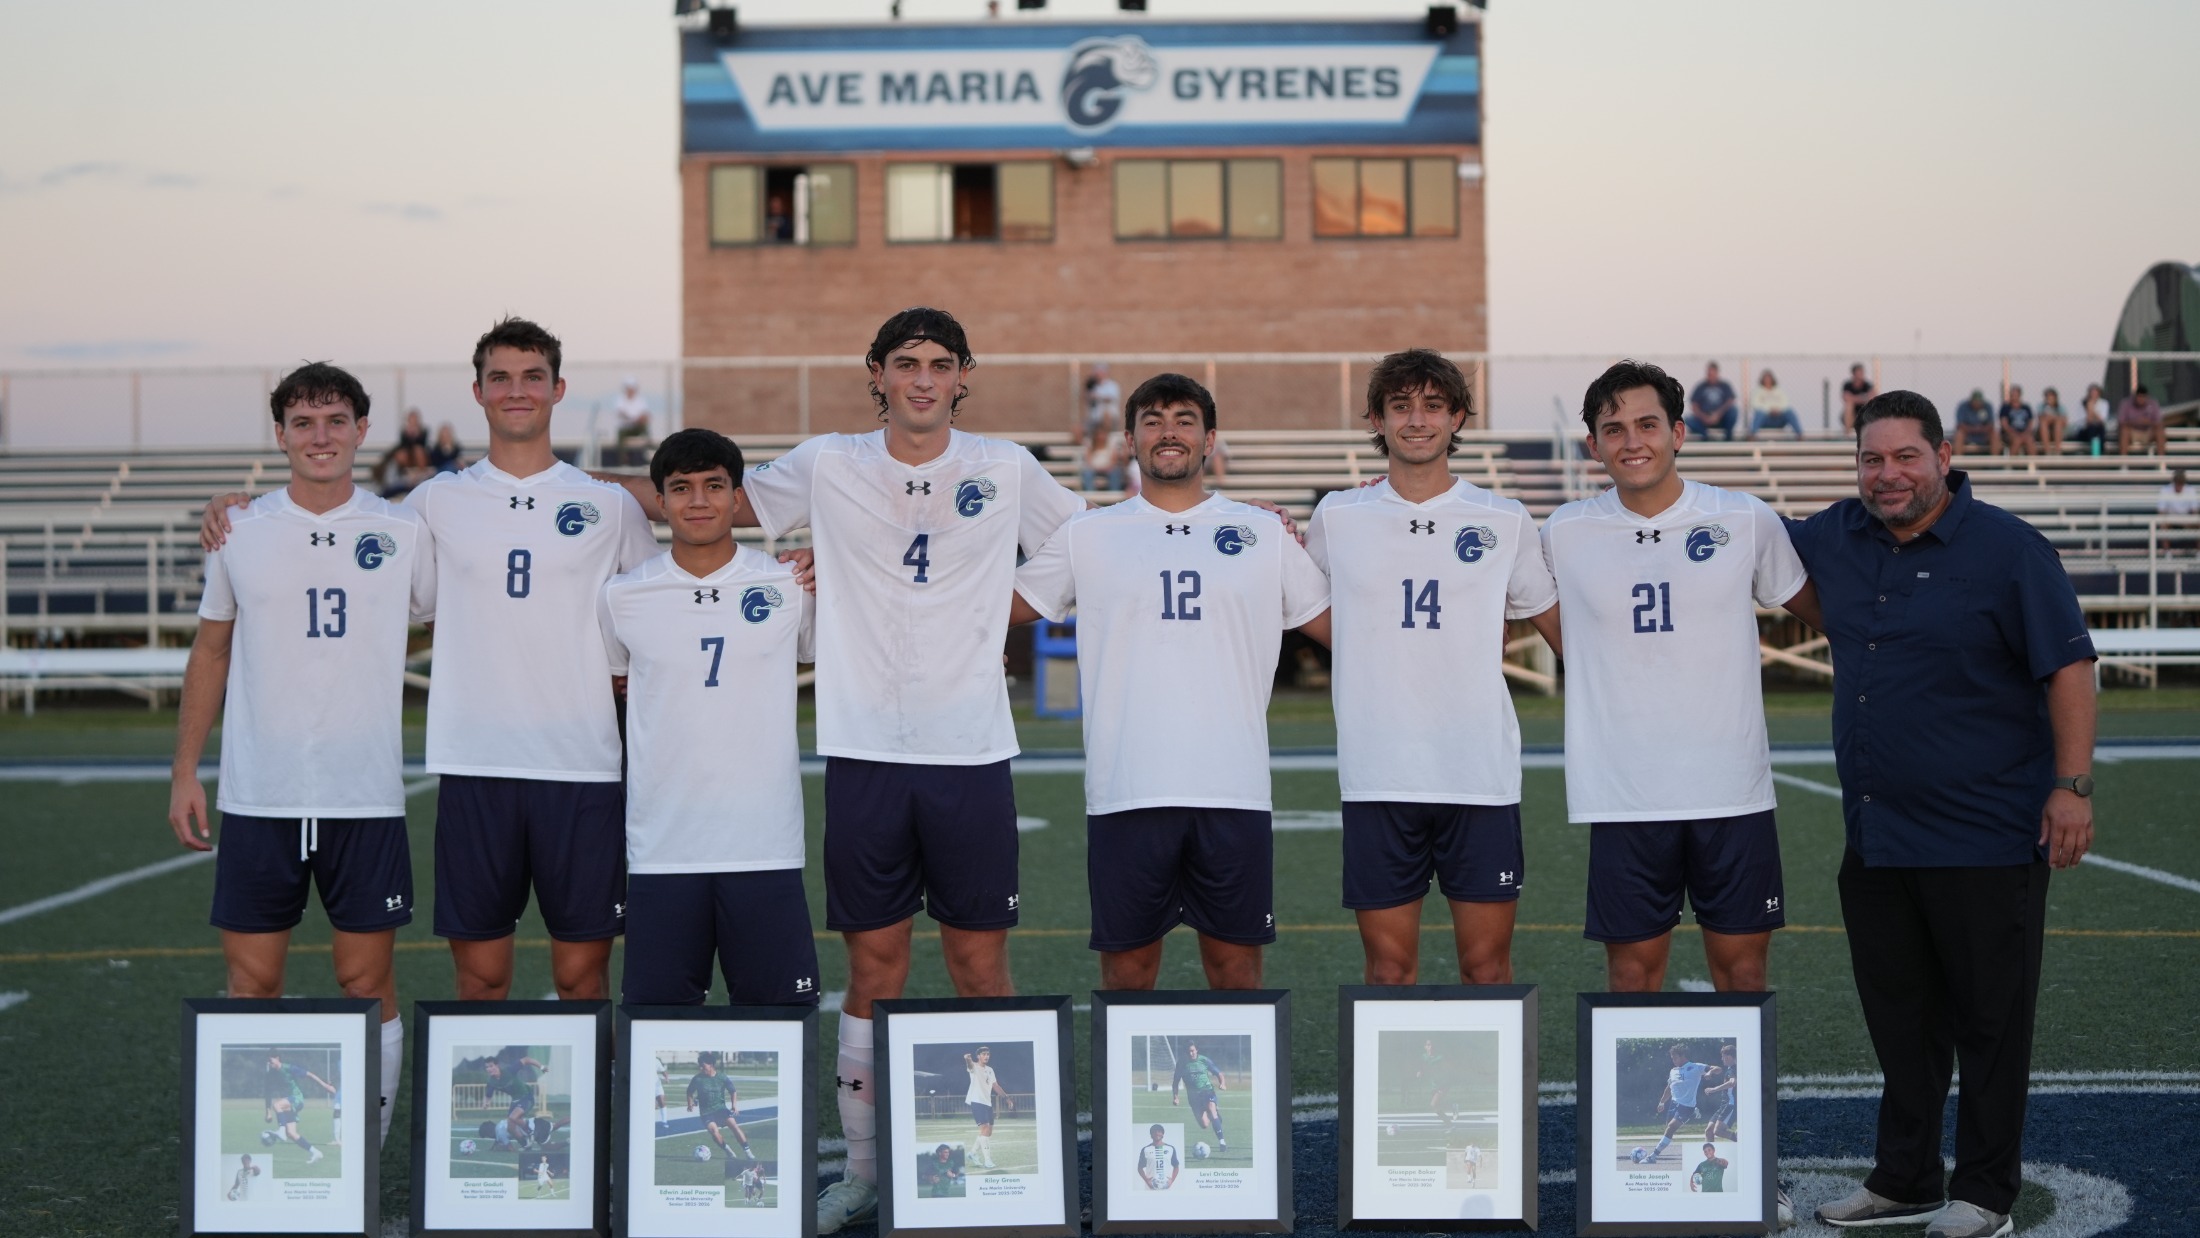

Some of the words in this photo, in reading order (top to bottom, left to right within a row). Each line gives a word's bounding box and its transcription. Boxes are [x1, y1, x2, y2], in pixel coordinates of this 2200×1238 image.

[767, 72, 864, 105] AVE
[879, 71, 1041, 104] MARIA
[1172, 66, 1402, 101] GYRENES
[507, 549, 532, 599] 8
[903, 533, 931, 584] 4
[306, 588, 347, 638] 13
[1159, 569, 1202, 621] 12
[1401, 579, 1442, 630] 14
[1632, 581, 1675, 634] 21
[701, 636, 725, 688] 7
[1648, 1173, 1670, 1181] Joseph
